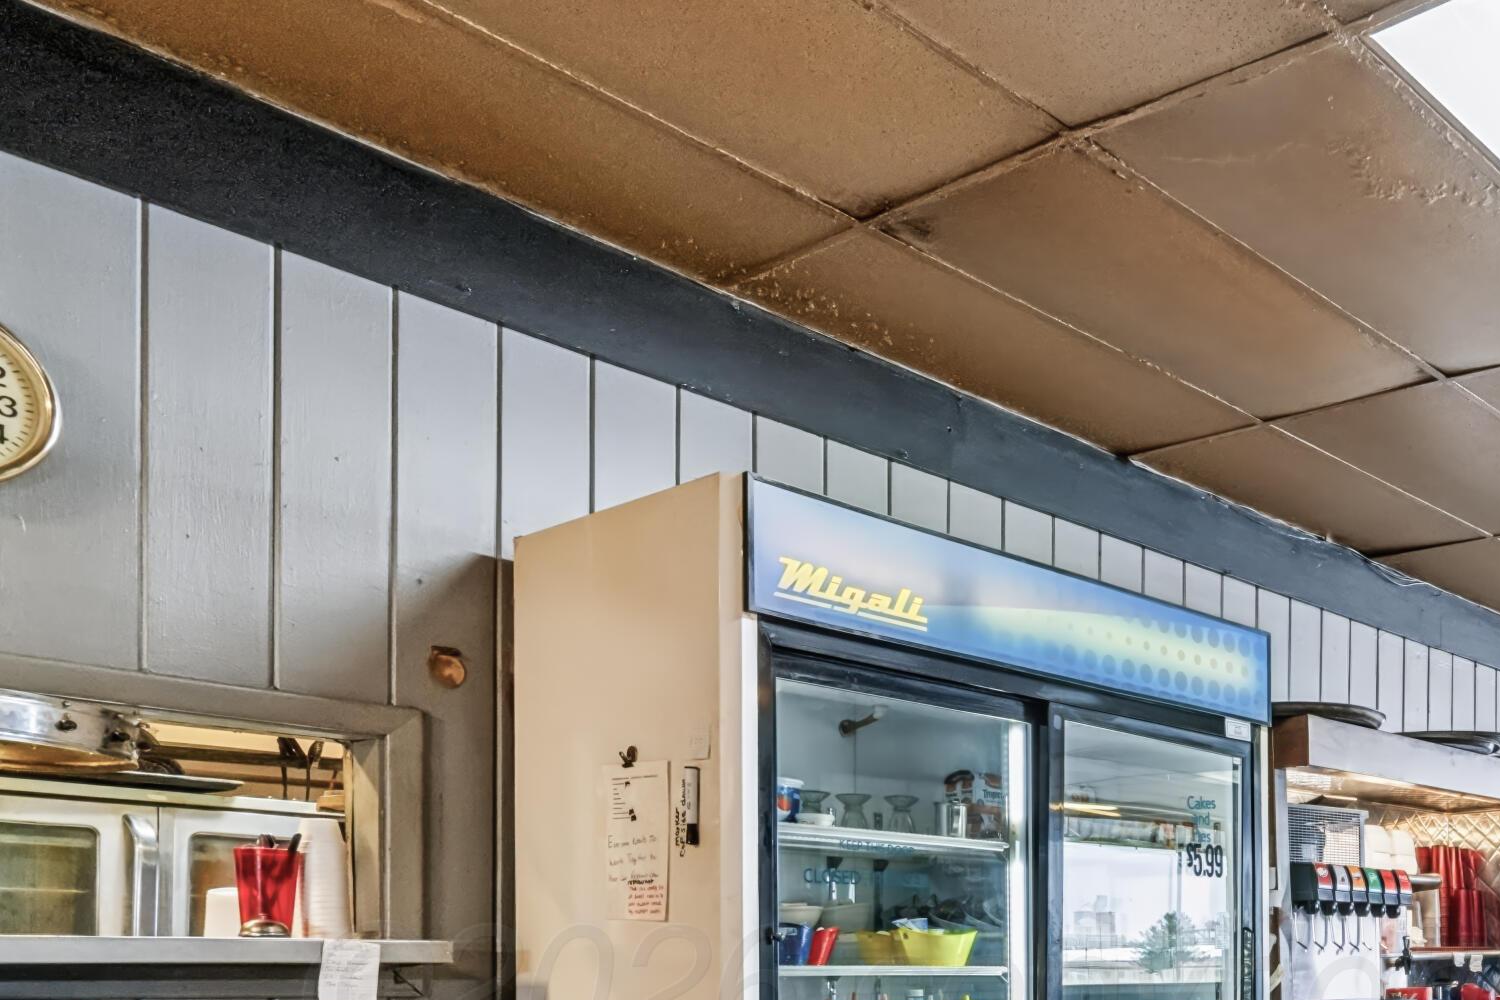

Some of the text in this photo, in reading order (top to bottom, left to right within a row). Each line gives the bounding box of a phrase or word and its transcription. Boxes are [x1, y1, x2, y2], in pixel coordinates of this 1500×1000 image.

[777, 556, 928, 623] Migali
[1187, 796, 1216, 810] Cakes
[1186, 844, 1223, 878] $5.99
[803, 867, 861, 885] CLOSED
